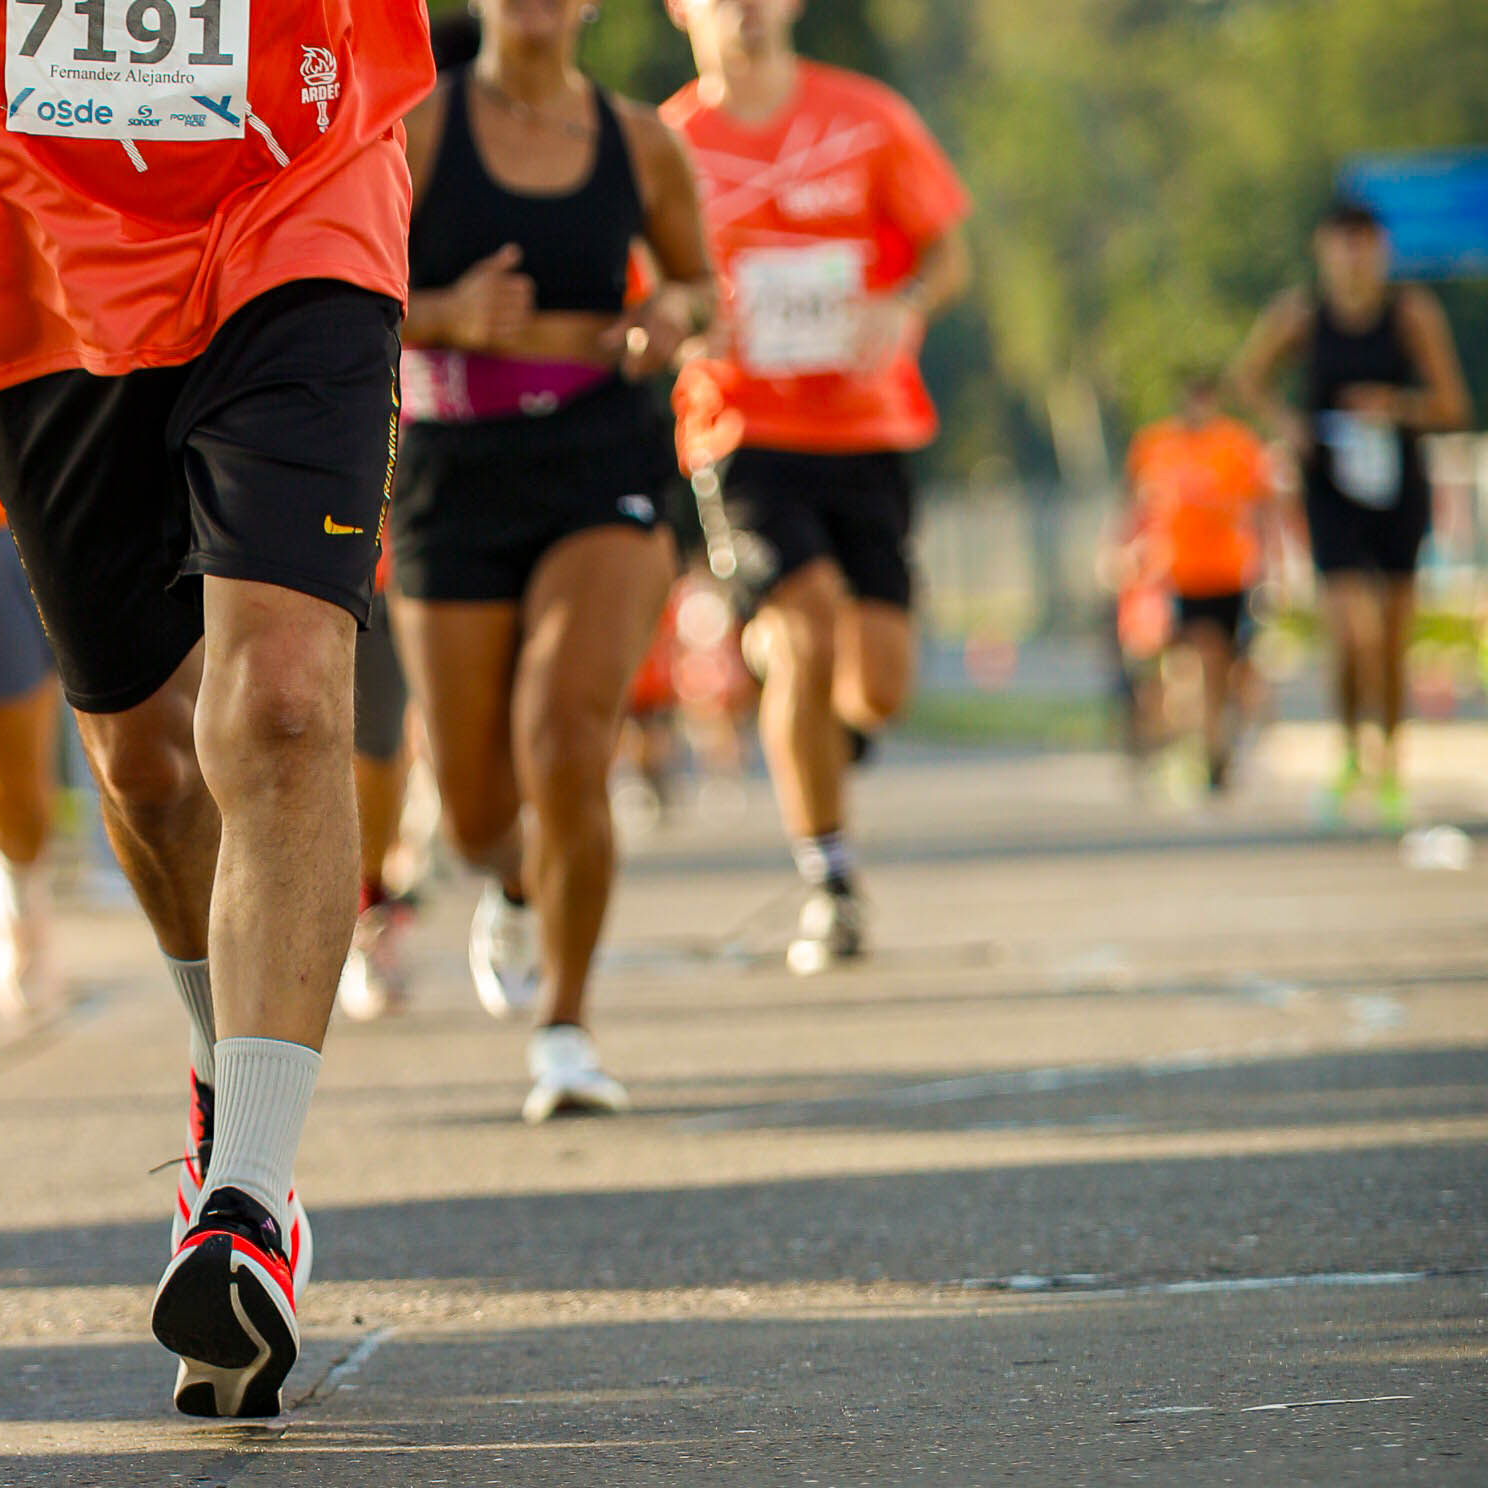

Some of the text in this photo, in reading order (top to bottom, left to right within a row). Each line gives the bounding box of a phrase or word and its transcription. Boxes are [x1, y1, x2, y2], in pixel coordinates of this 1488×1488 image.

[50, 64, 195, 87] Fernandez Alejandro
[37, 98, 113, 126] osde
[170, 113, 208, 121] POWER
[384, 411, 397, 500] RUNNING
